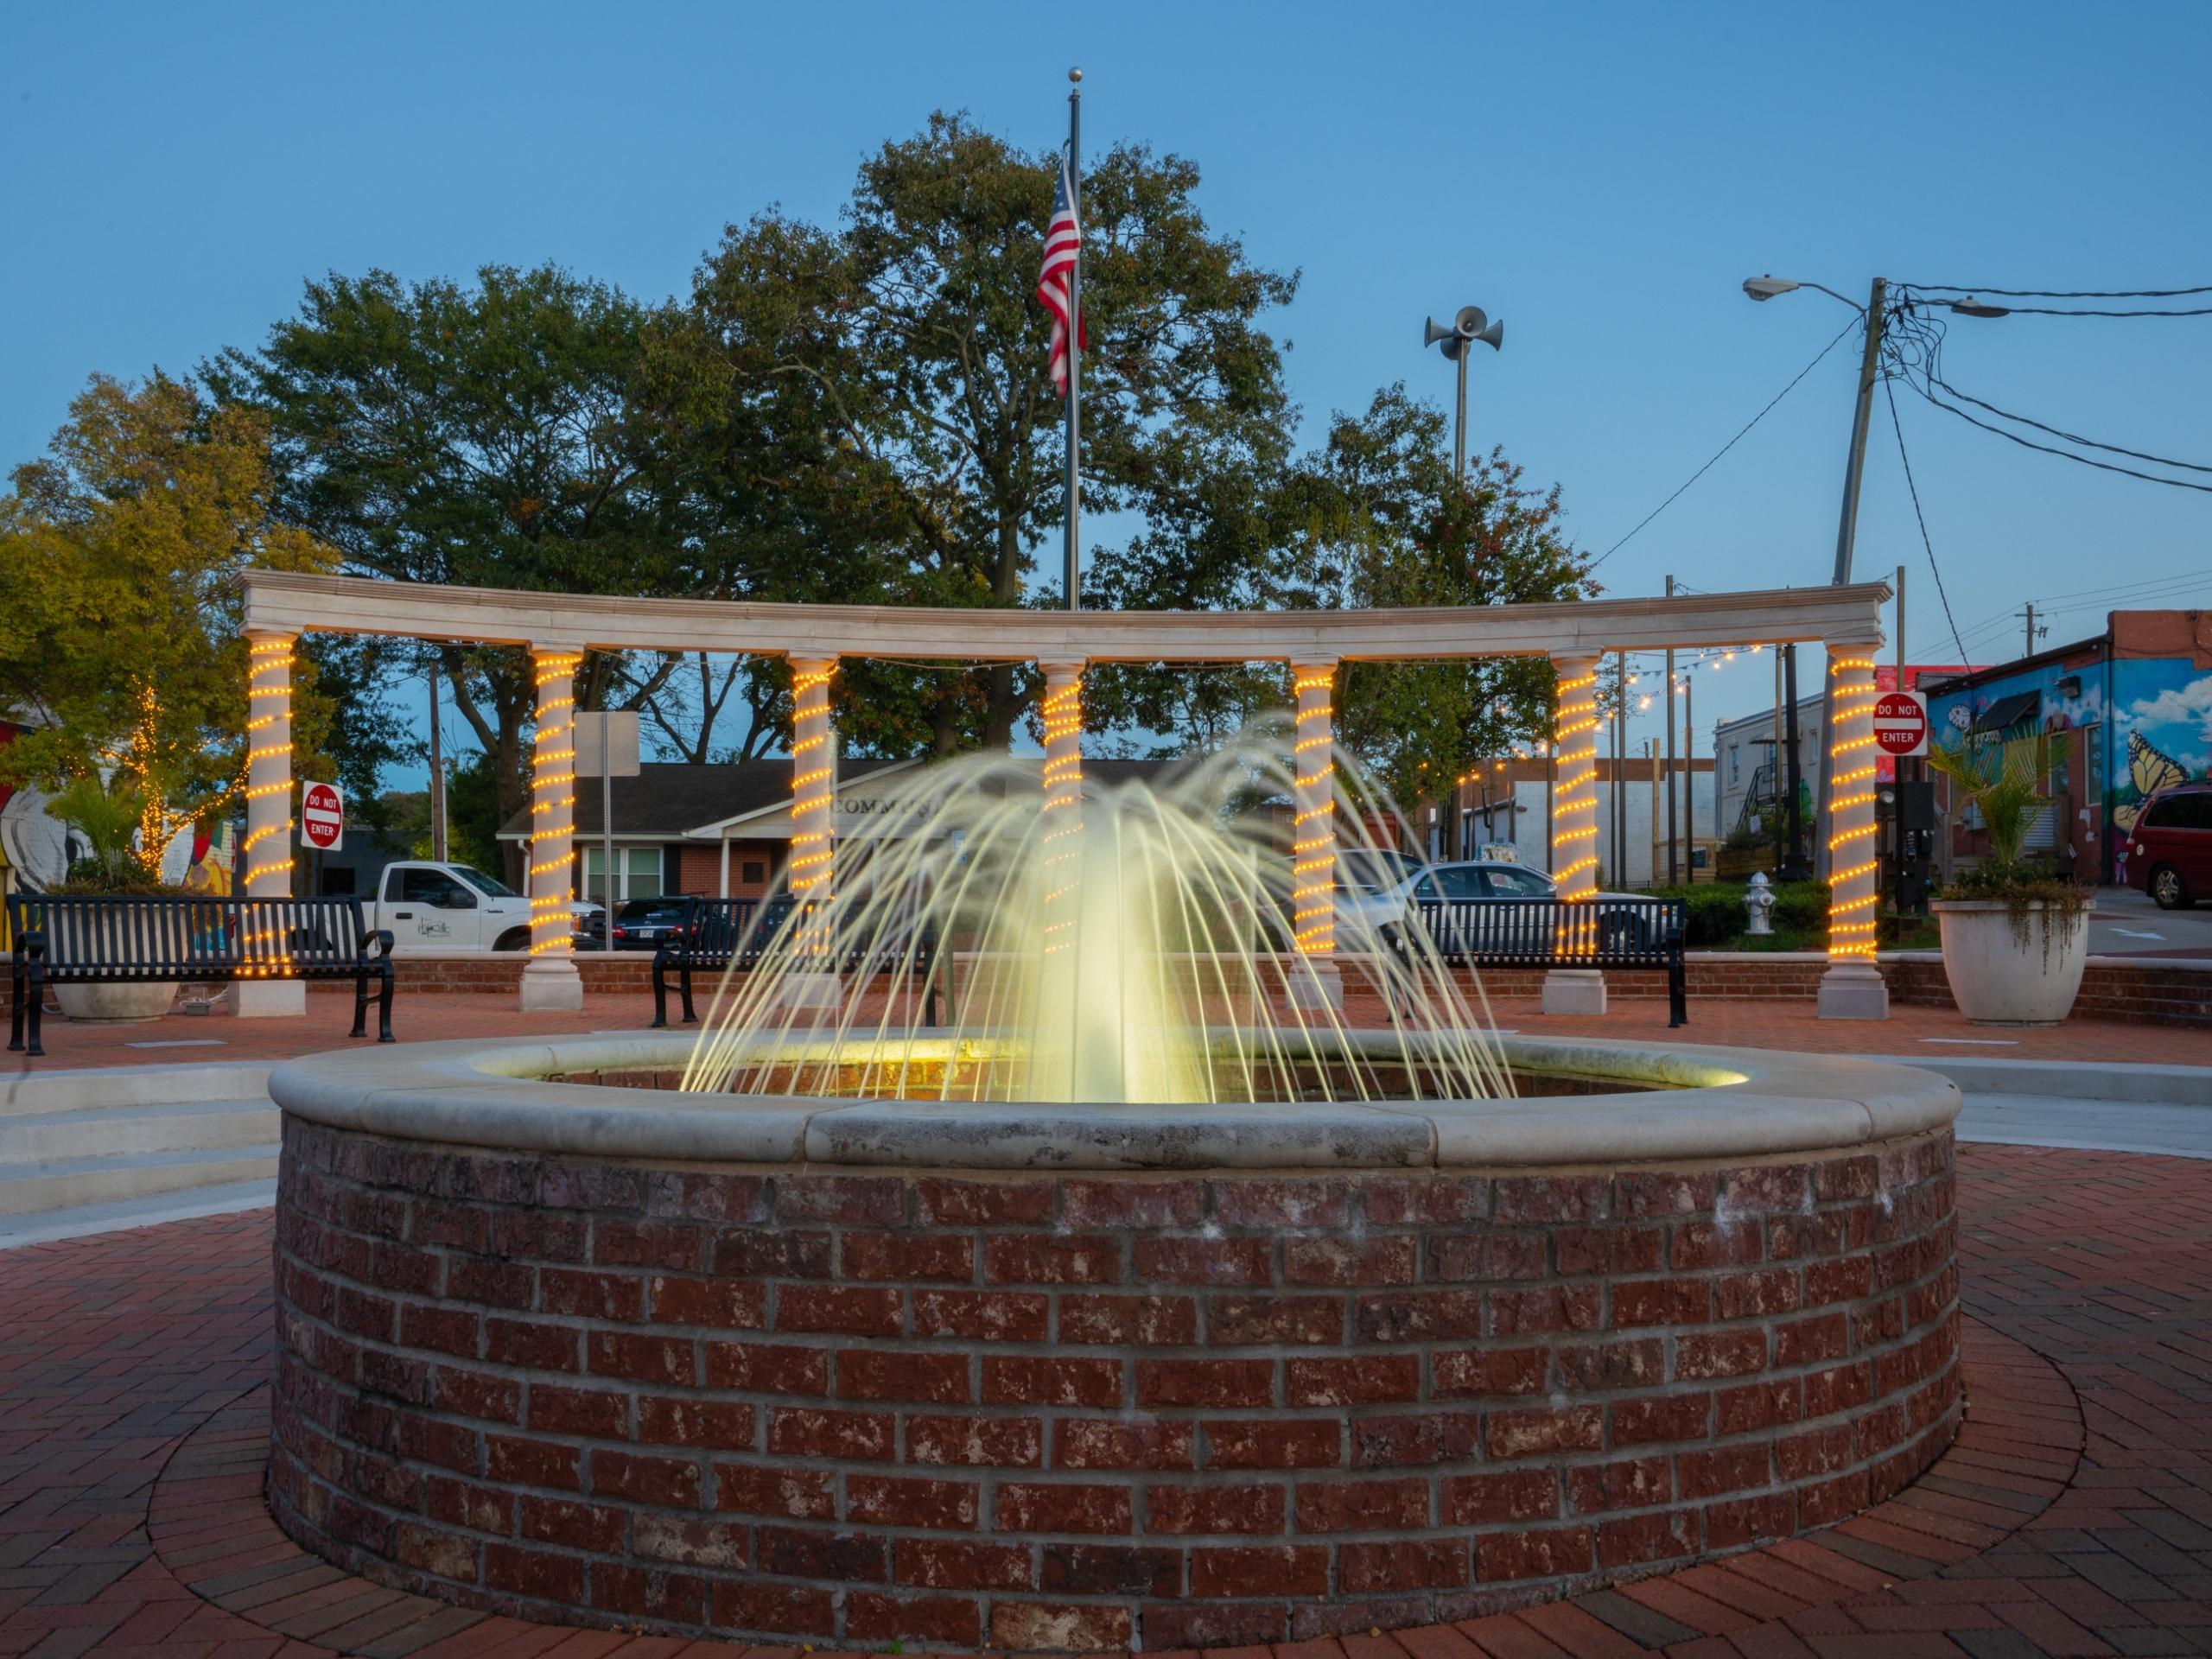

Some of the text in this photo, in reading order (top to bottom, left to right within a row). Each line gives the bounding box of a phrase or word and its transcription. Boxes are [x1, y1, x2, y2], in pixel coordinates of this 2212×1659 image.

[1878, 704, 1917, 715] DO NOT
[1882, 732, 1914, 742] ENTER
[309, 794, 337, 810] DO NOT
[311, 823, 334, 836] ENTER
